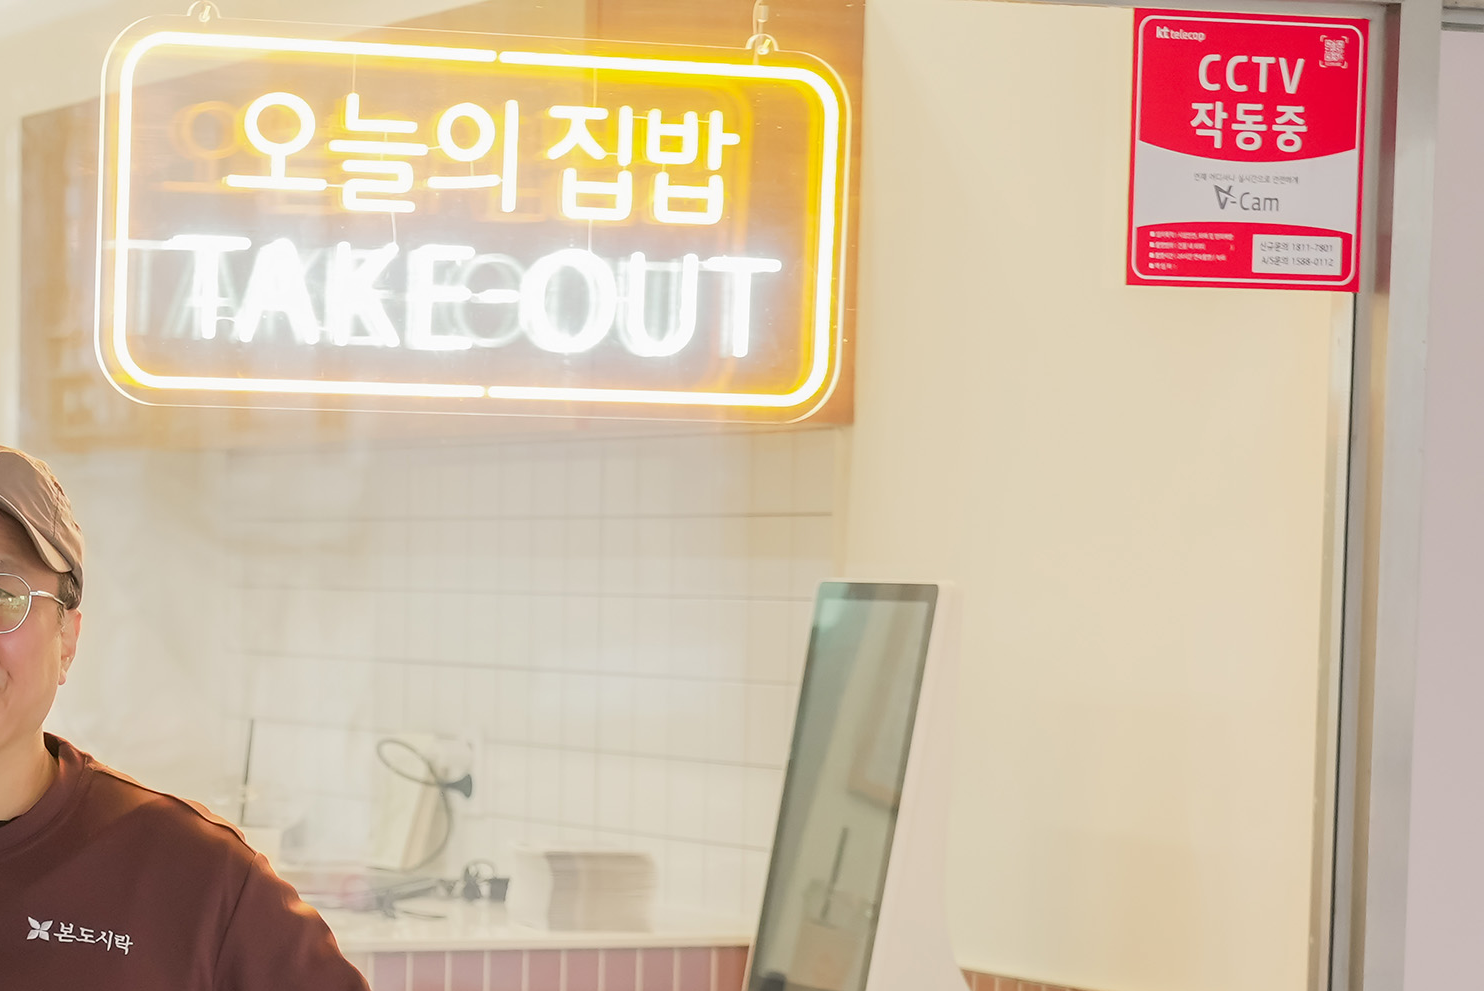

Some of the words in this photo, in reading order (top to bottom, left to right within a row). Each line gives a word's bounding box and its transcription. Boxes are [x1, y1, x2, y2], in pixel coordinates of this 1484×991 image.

[1156, 25, 1170, 39] kt
[1198, 53, 1306, 95] CCTV
[1189, 101, 1308, 153] 작동중
[221, 91, 518, 213] 오늘의
[546, 103, 742, 225] 집밥
[53, 921, 135, 956] 본도시락
